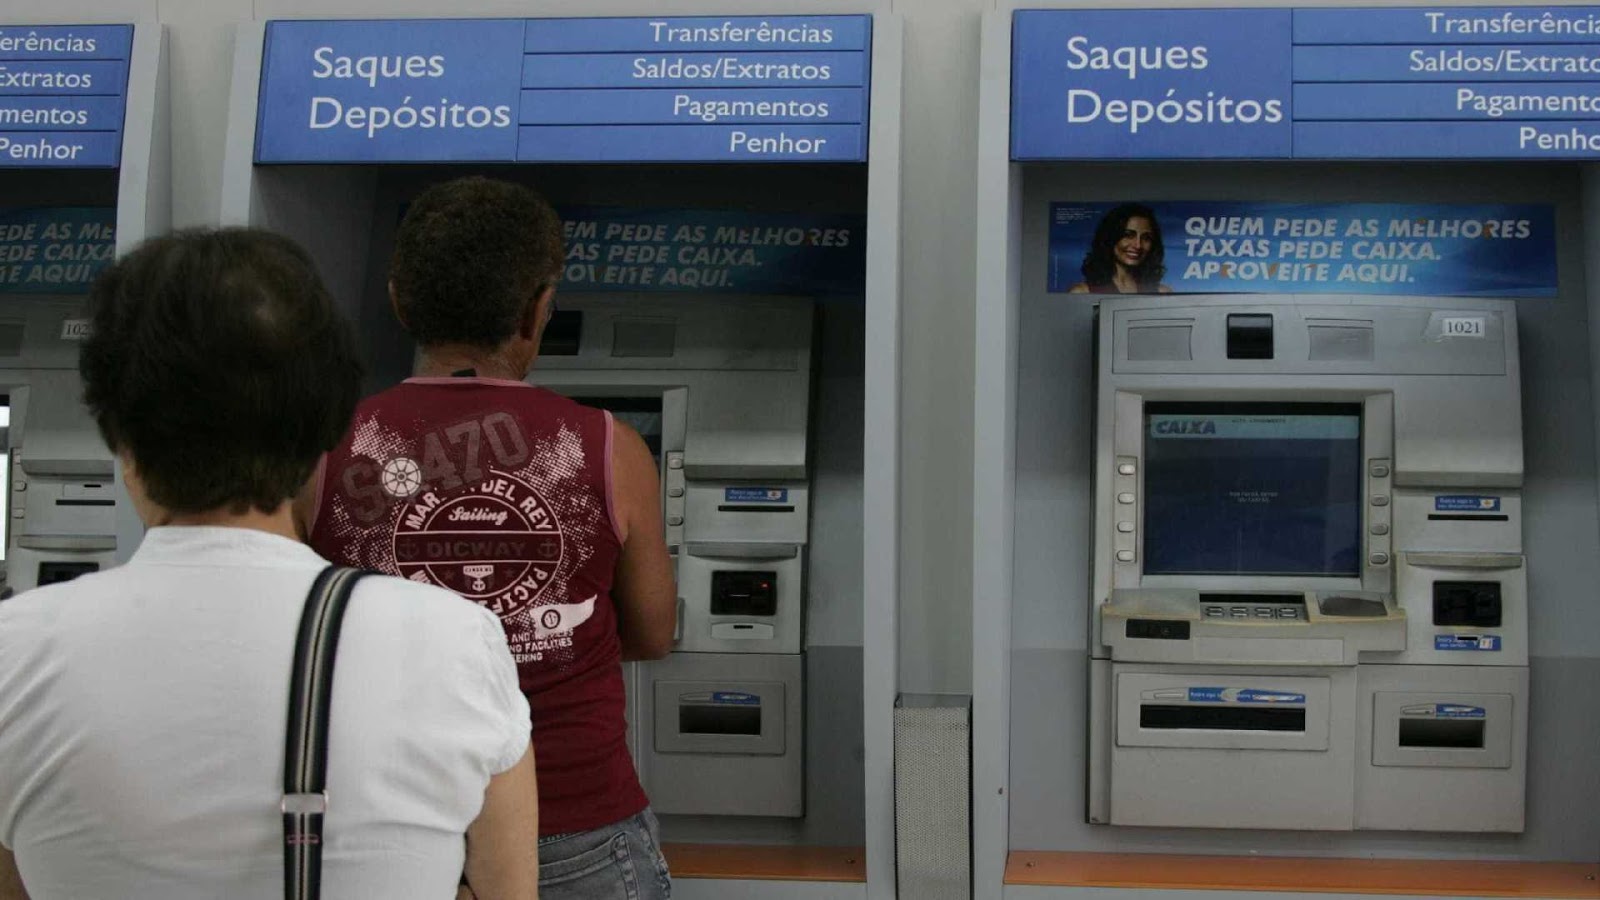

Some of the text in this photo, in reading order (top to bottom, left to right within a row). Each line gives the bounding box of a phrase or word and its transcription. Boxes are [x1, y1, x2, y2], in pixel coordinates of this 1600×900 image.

[0, 31, 96, 52] erências
[649, 22, 833, 43] Transferências
[313, 47, 445, 87] Saques
[632, 58, 831, 79] Saldos/Extratos
[1067, 36, 1209, 79] Saques
[309, 96, 511, 138] Depósitos
[673, 95, 829, 122] Pagamentos
[1067, 89, 1283, 133] Depósitos
[730, 131, 826, 153] Penhor
[40, 221, 73, 240] AS
[604, 222, 668, 242] PEDE
[674, 224, 706, 242] AS
[1184, 216, 1531, 240] QUEM PEDE AS MELHORES
[562, 242, 763, 267] AS PEDE CAIXA.
[1185, 239, 1442, 261] TAXAS PEDE CAIXA.
[659, 267, 735, 288] AQUI.
[1183, 261, 1415, 284] APROVEITE AQUI.
[1446, 320, 1481, 335] 1021
[1156, 420, 1216, 435] CAIXA
[448, 506, 508, 525] Sailing
[519, 496, 552, 529] REY
